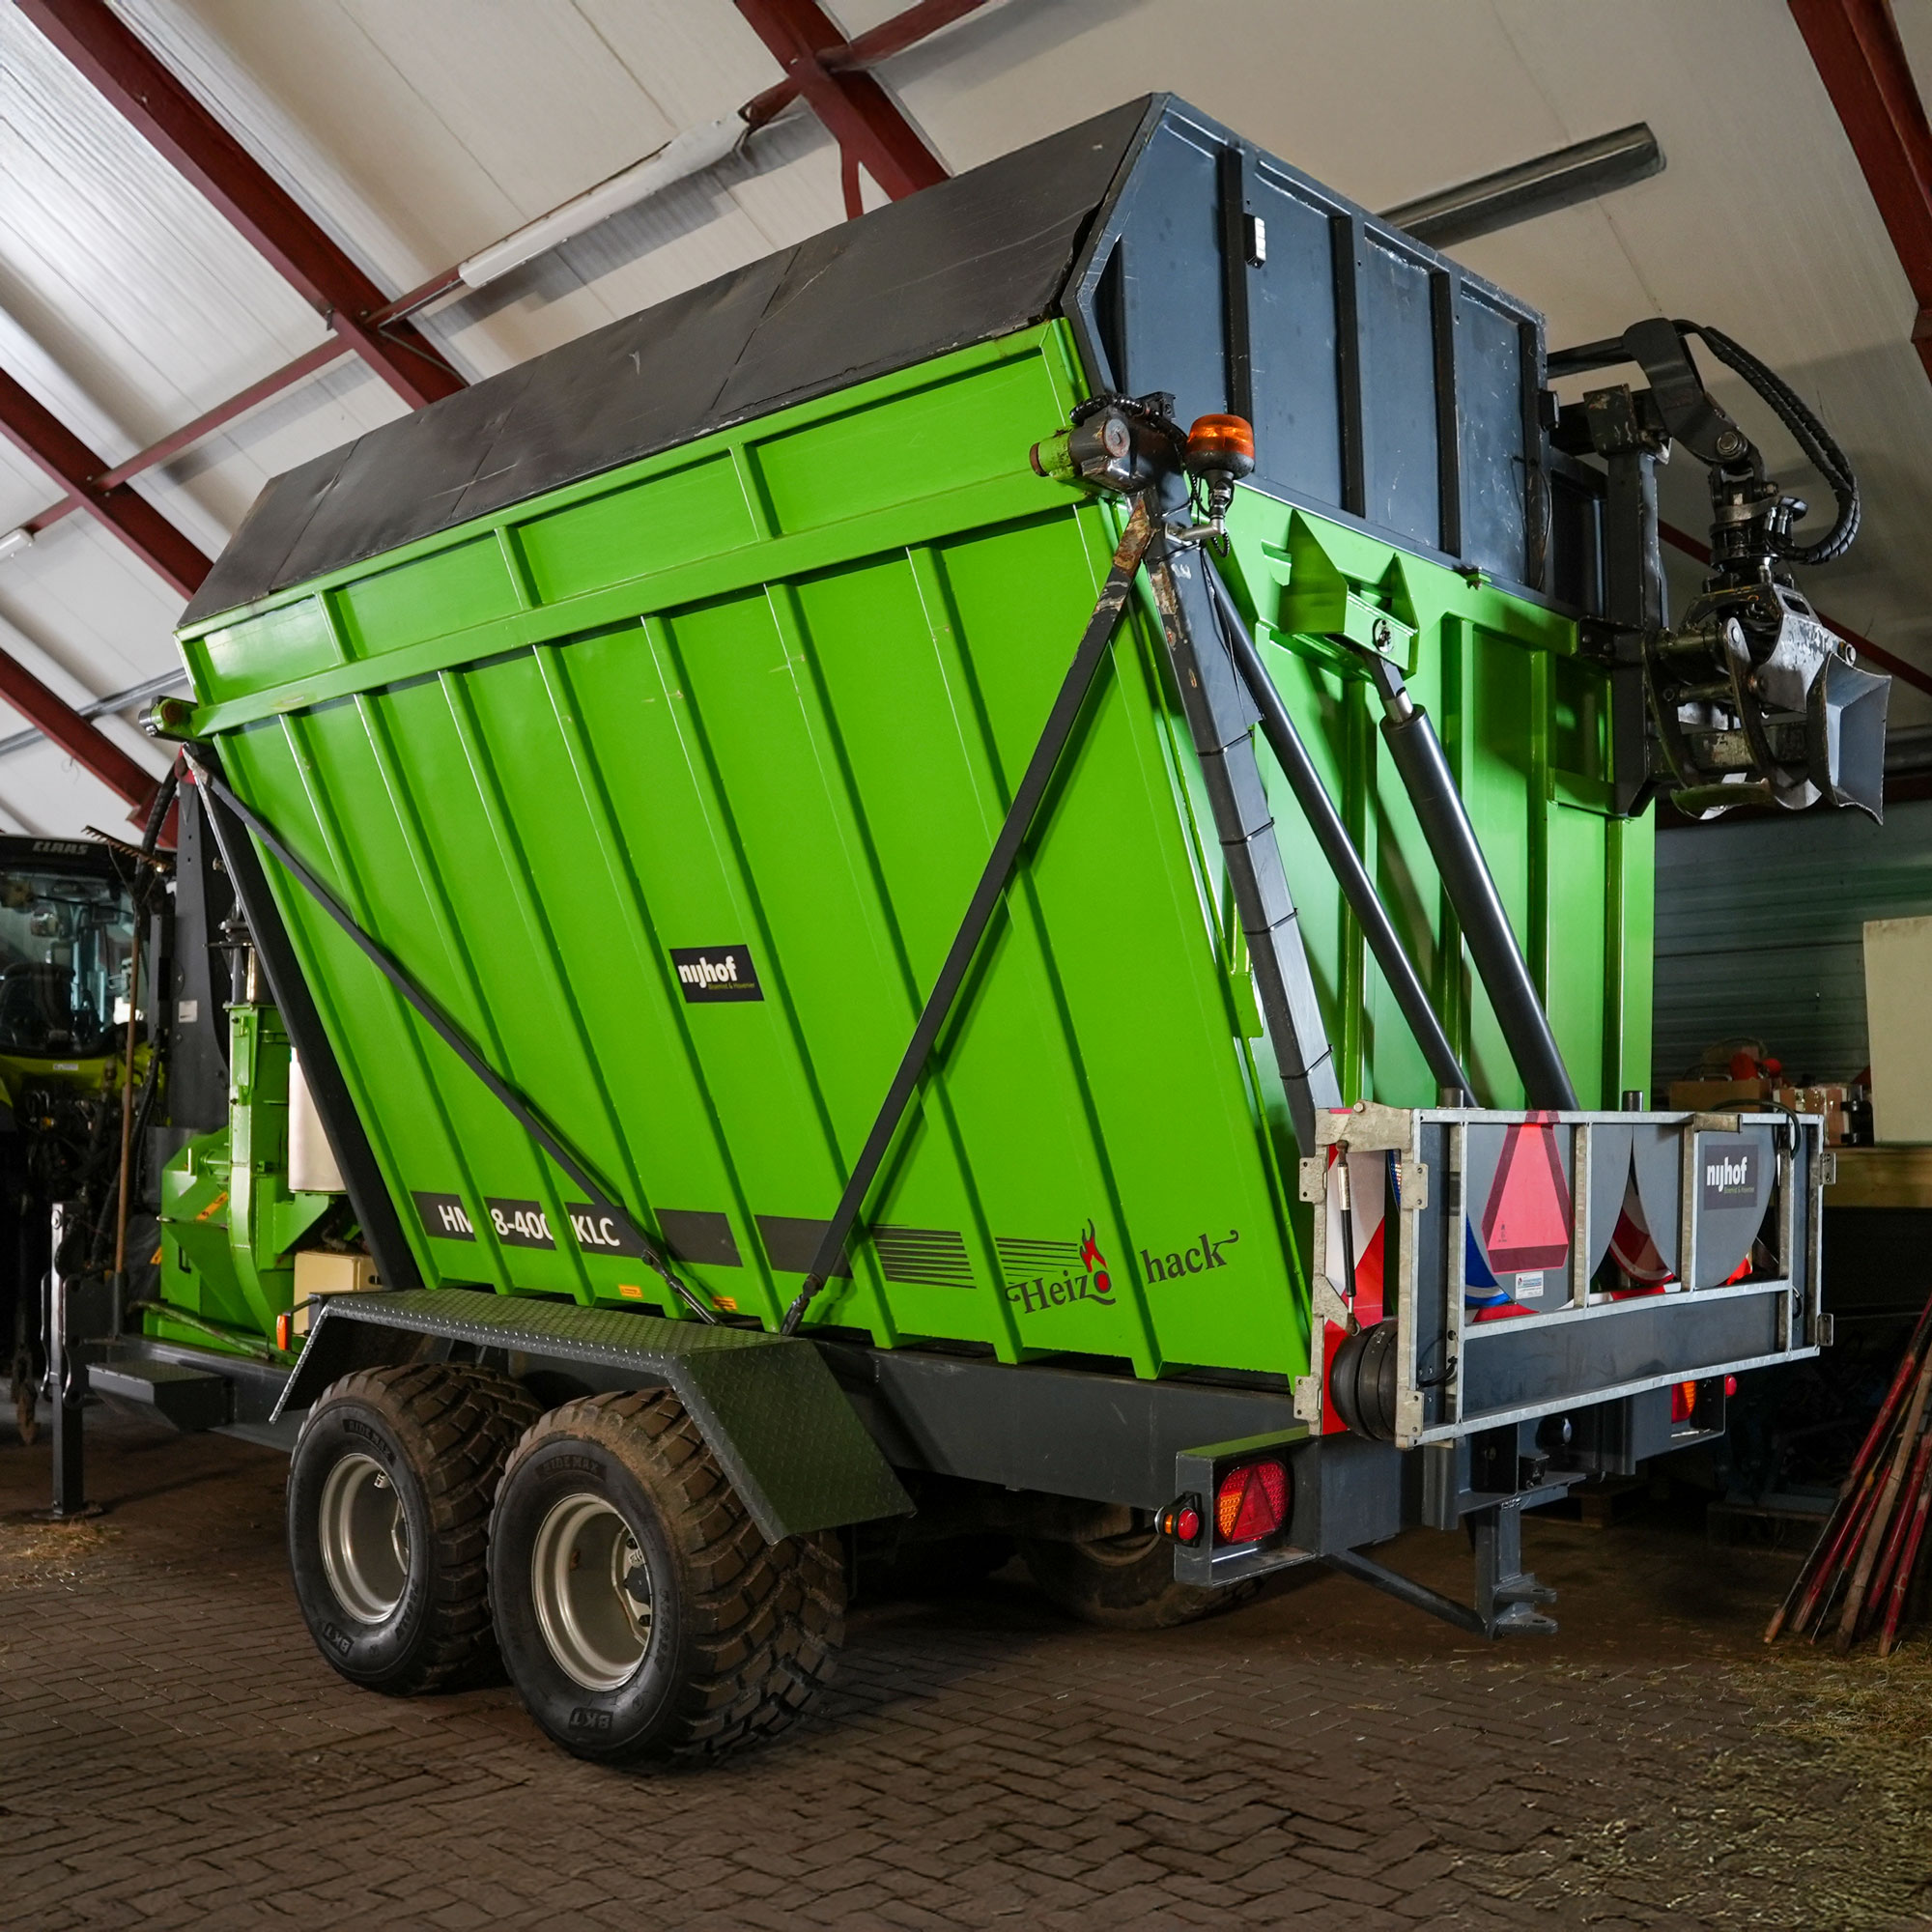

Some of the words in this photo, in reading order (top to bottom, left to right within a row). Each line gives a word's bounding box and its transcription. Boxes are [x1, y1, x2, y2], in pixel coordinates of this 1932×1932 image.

[32, 840, 89, 855] CLAAS
[678, 955, 737, 988] nijhof
[1707, 1156, 1747, 1192] nijhof
[570, 1214, 620, 1247] KLC
[324, 1625, 352, 1654] BKT
[570, 1711, 611, 1729] BKT
